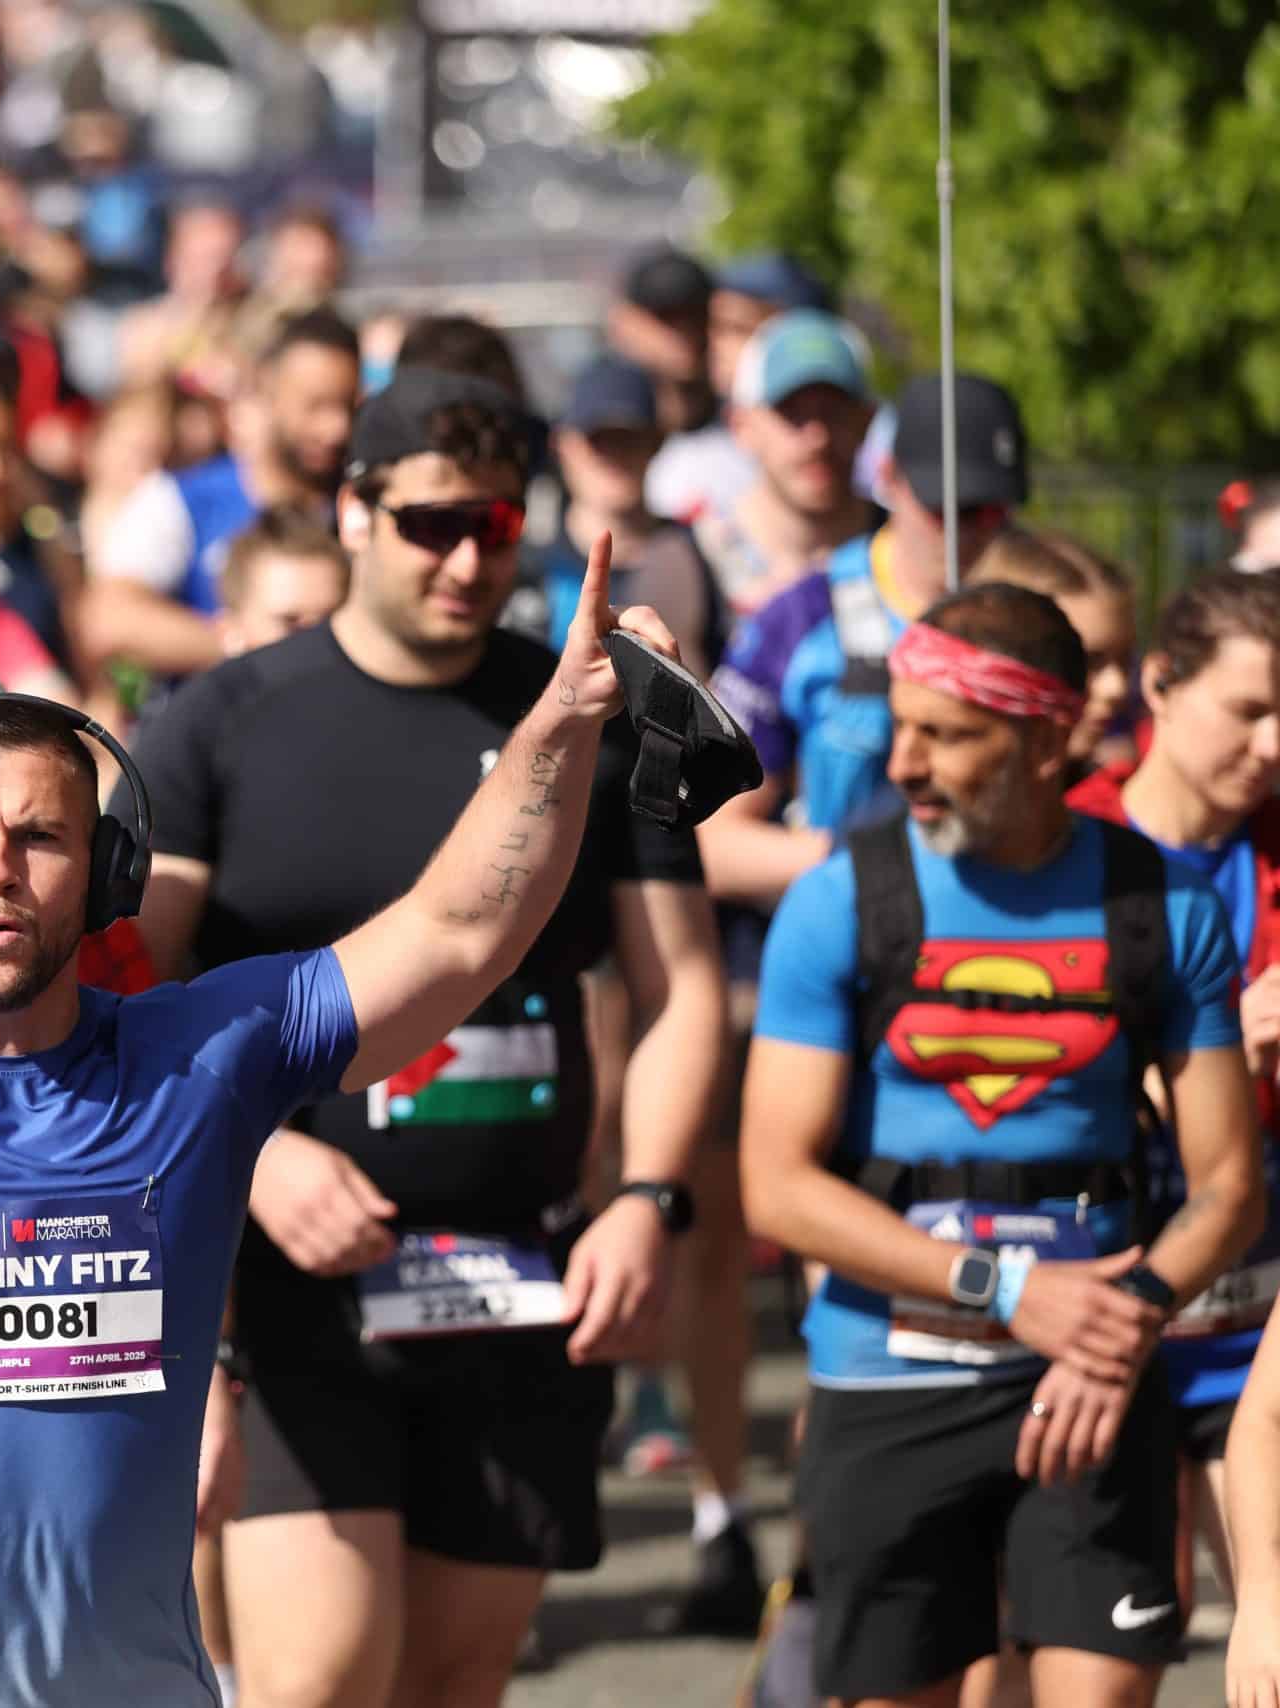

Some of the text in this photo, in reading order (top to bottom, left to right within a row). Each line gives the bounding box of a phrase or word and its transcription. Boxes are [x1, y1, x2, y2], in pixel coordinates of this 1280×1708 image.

[36, 1215, 109, 1228] MANCHESTER
[36, 1225, 111, 1241] MARATHON
[71, 1250, 151, 1285] FITZ
[69, 1351, 146, 1366] 27TH APRIL 2025
[14, 1383, 55, 1394] T-SHIRT
[57, 1383, 70, 1392] AT
[72, 1381, 104, 1391] FINISH
[106, 1379, 127, 1389] LINE
